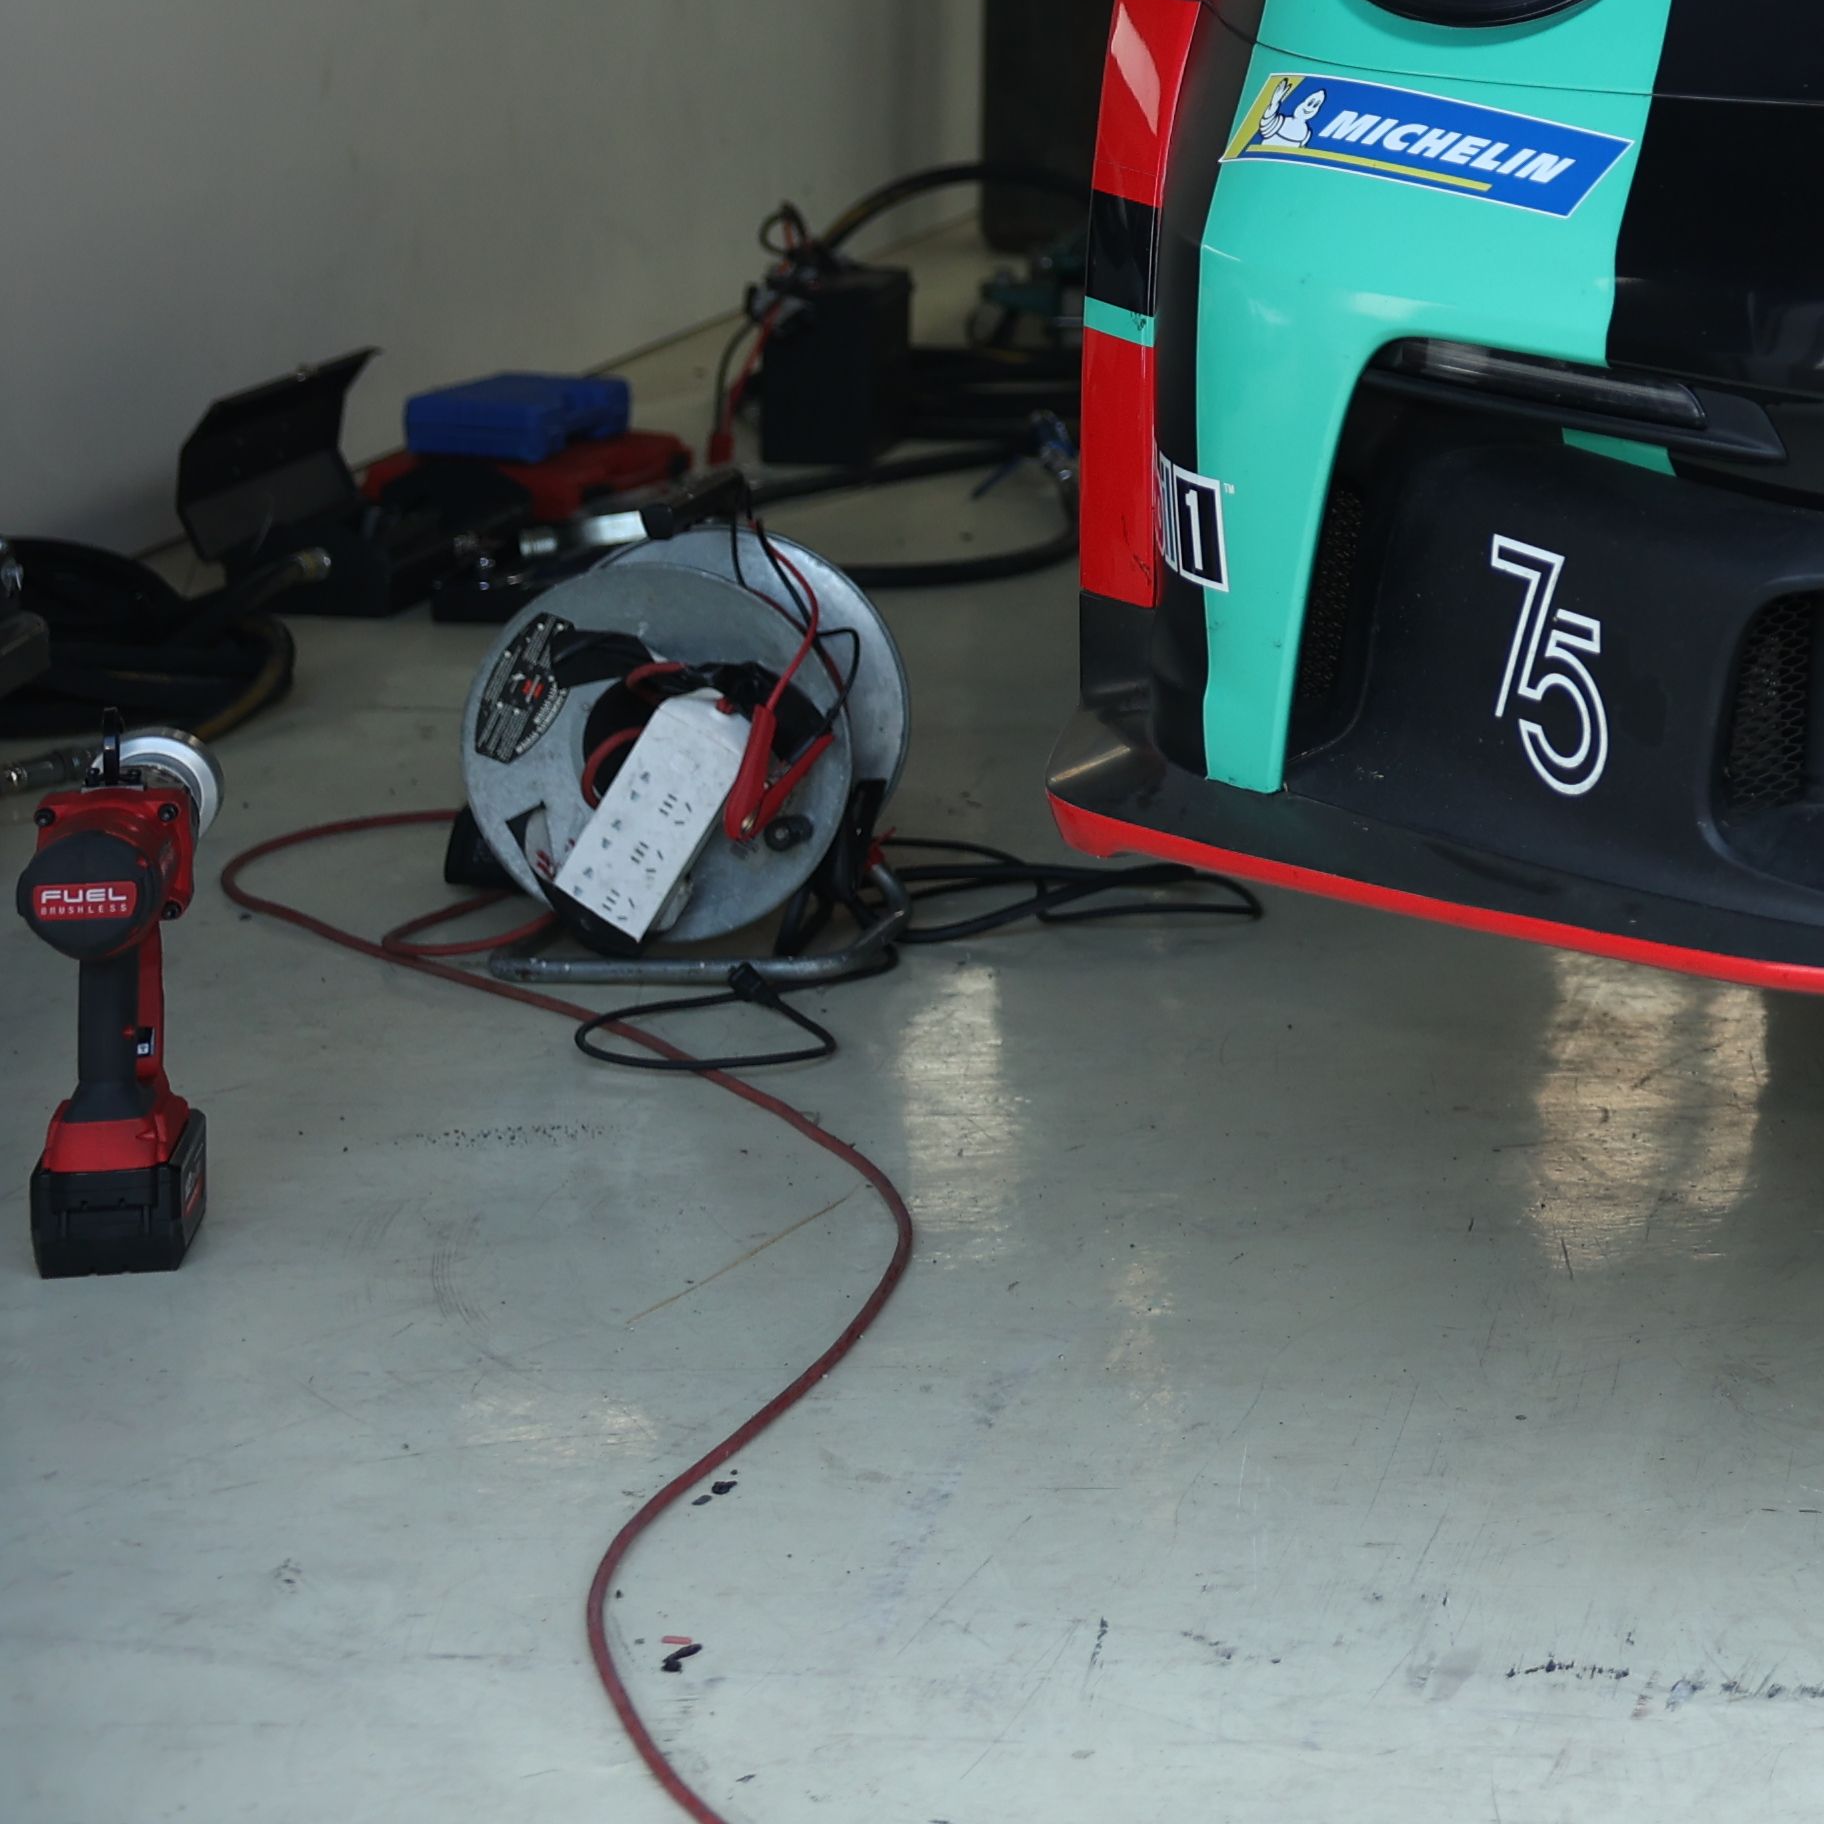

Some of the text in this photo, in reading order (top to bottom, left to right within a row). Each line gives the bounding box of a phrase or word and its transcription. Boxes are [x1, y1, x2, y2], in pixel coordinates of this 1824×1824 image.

[1319, 110, 1576, 185] MICHELIN
[1491, 533, 1608, 796] 75
[40, 887, 127, 904] FUEL
[40, 904, 127, 916] BRUSHLESS
